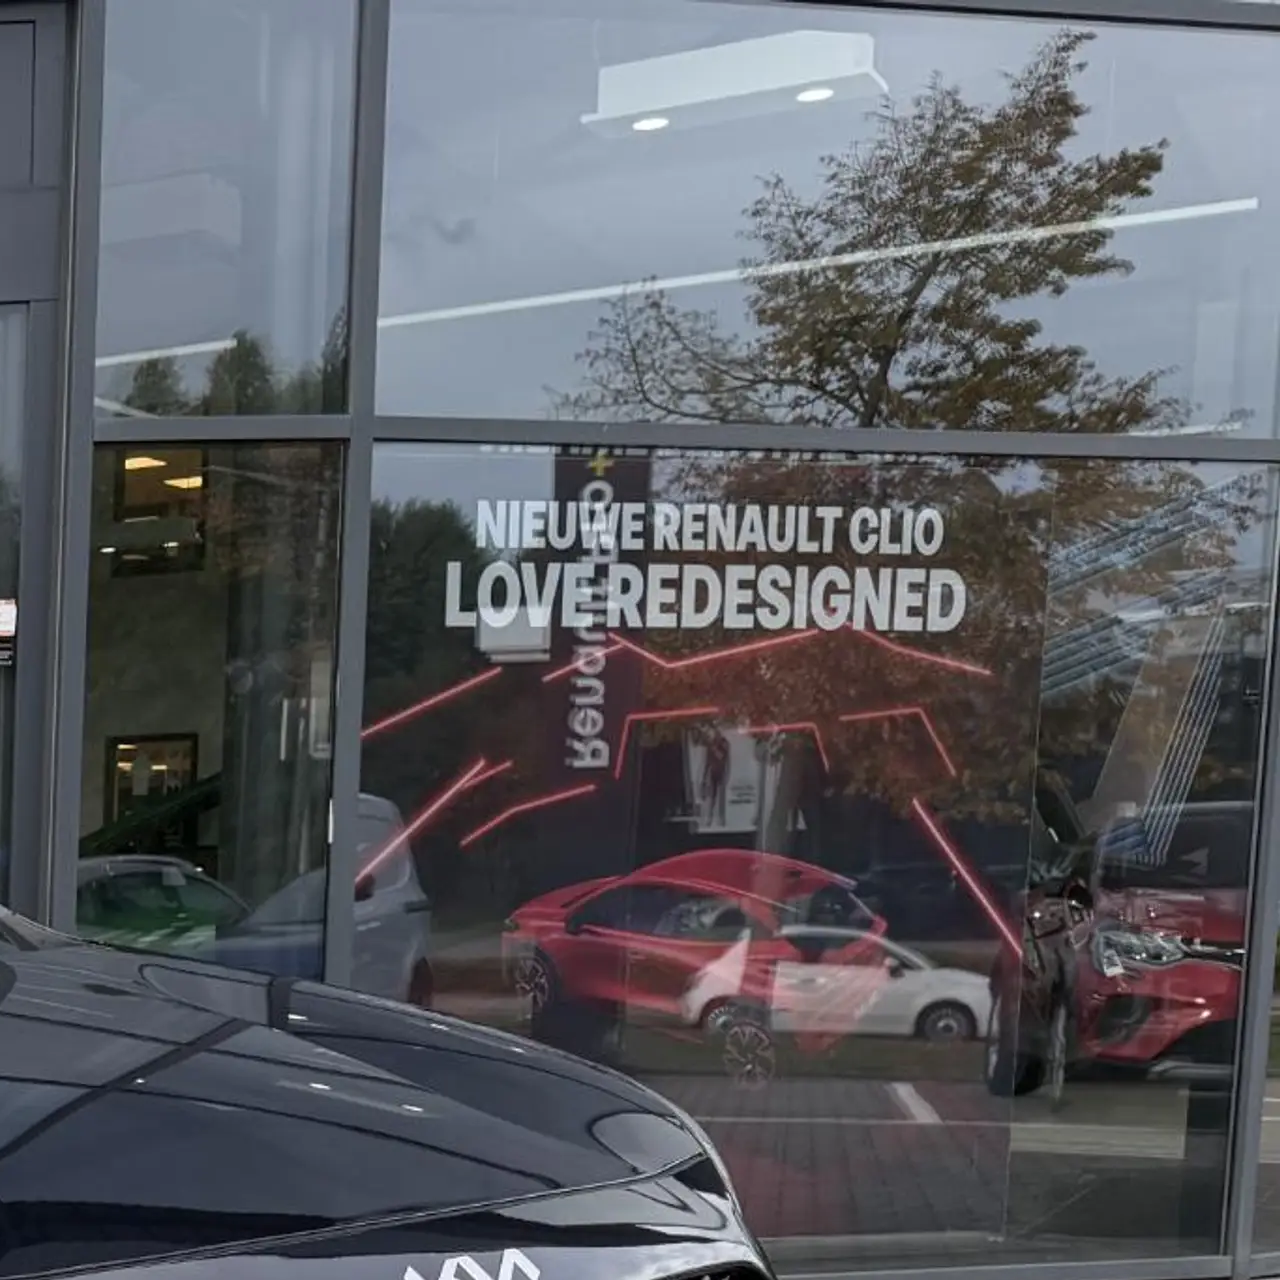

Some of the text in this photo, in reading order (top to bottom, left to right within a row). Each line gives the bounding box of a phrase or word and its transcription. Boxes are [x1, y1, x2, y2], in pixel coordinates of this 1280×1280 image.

[475, 500, 944, 556] NIEUWE RENAULT CLIO
[445, 560, 966, 633] LOVE REDESIGNED
